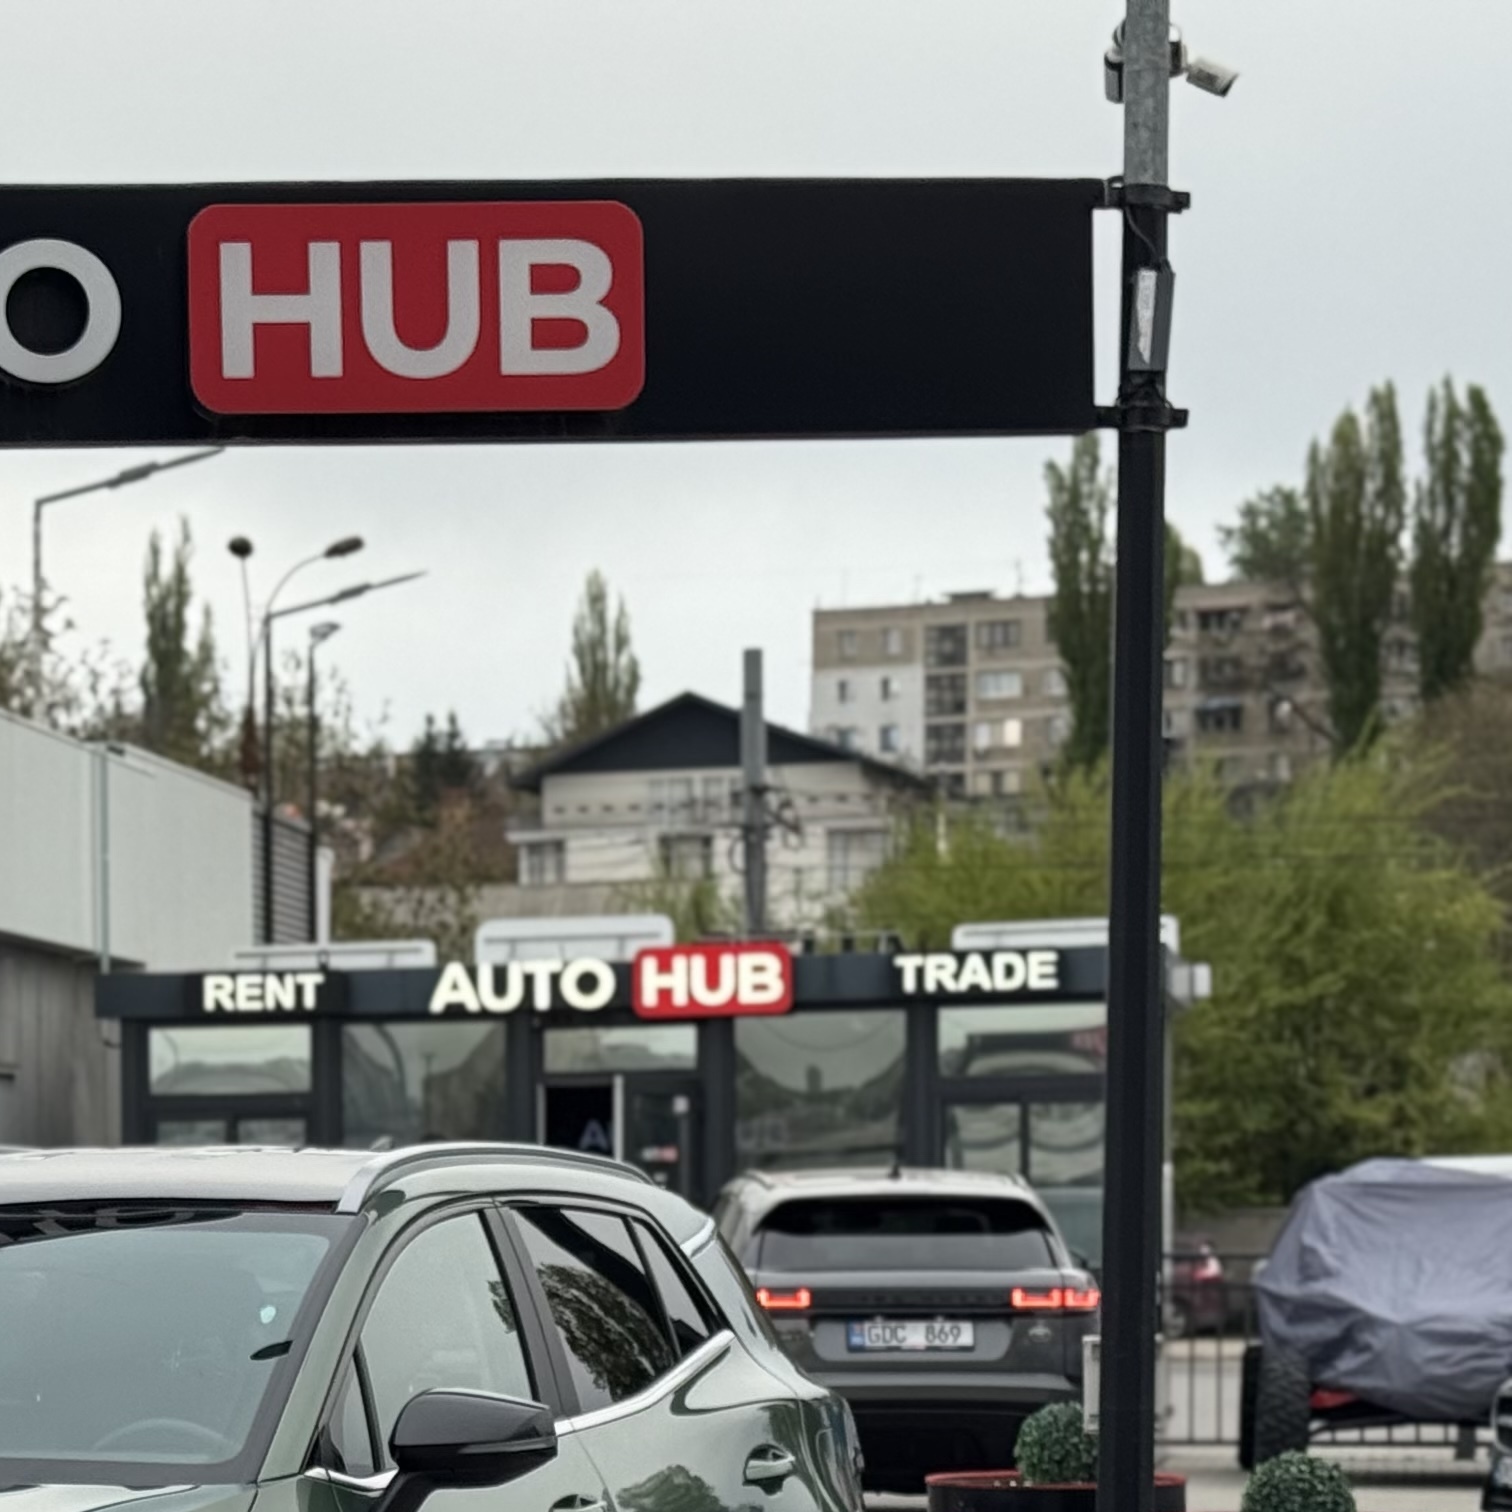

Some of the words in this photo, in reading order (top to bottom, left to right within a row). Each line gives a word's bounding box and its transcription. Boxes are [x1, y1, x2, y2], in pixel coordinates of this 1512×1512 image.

[219, 238, 621, 379] HUB
[202, 972, 326, 1012] RENT
[429, 957, 617, 1014] AUTO
[640, 950, 786, 1009] HUB
[893, 950, 1059, 994] TRADE
[924, 1323, 962, 1343] 869
